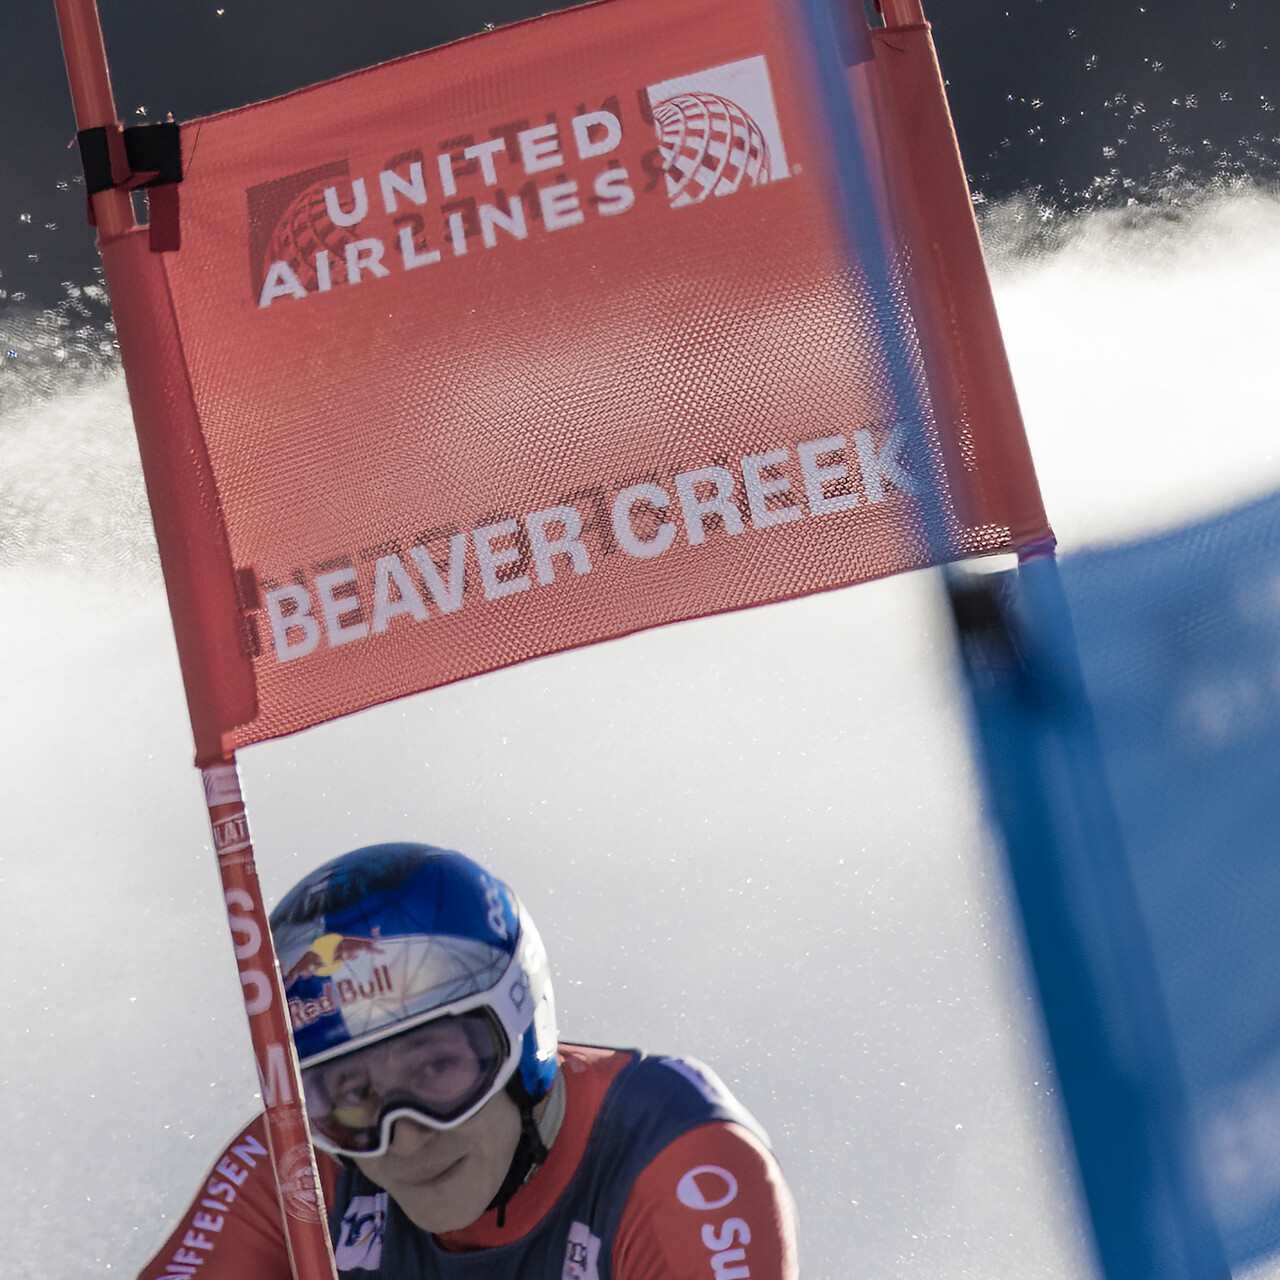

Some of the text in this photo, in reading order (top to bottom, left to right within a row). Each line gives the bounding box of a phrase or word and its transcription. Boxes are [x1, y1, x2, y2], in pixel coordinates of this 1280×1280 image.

[323, 110, 623, 228] UNITED
[258, 167, 636, 309] AIRLINES
[265, 427, 916, 664] BEAVER CREEK
[289, 964, 393, 1029] Red Bull
